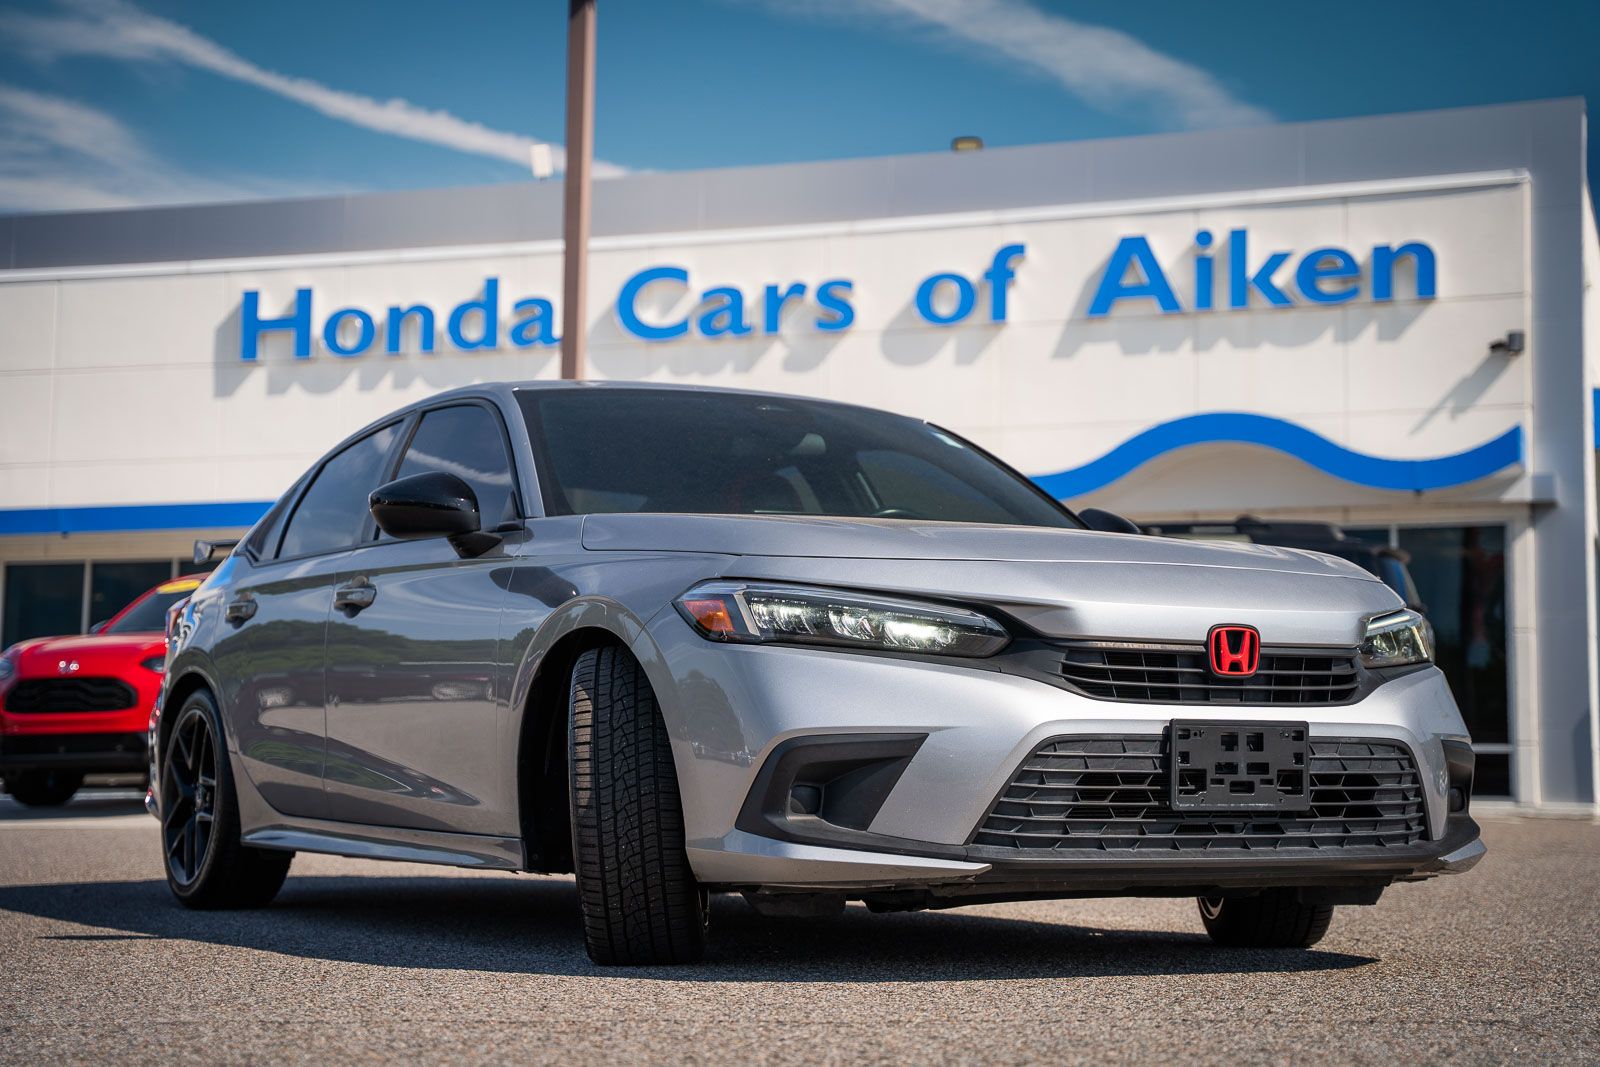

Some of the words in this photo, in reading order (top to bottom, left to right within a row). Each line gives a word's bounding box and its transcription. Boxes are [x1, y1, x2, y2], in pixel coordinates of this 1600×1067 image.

[240, 277, 563, 362] Honda
[616, 266, 855, 342] Cars
[915, 243, 1026, 326] of
[1087, 228, 1437, 317] Aiken
